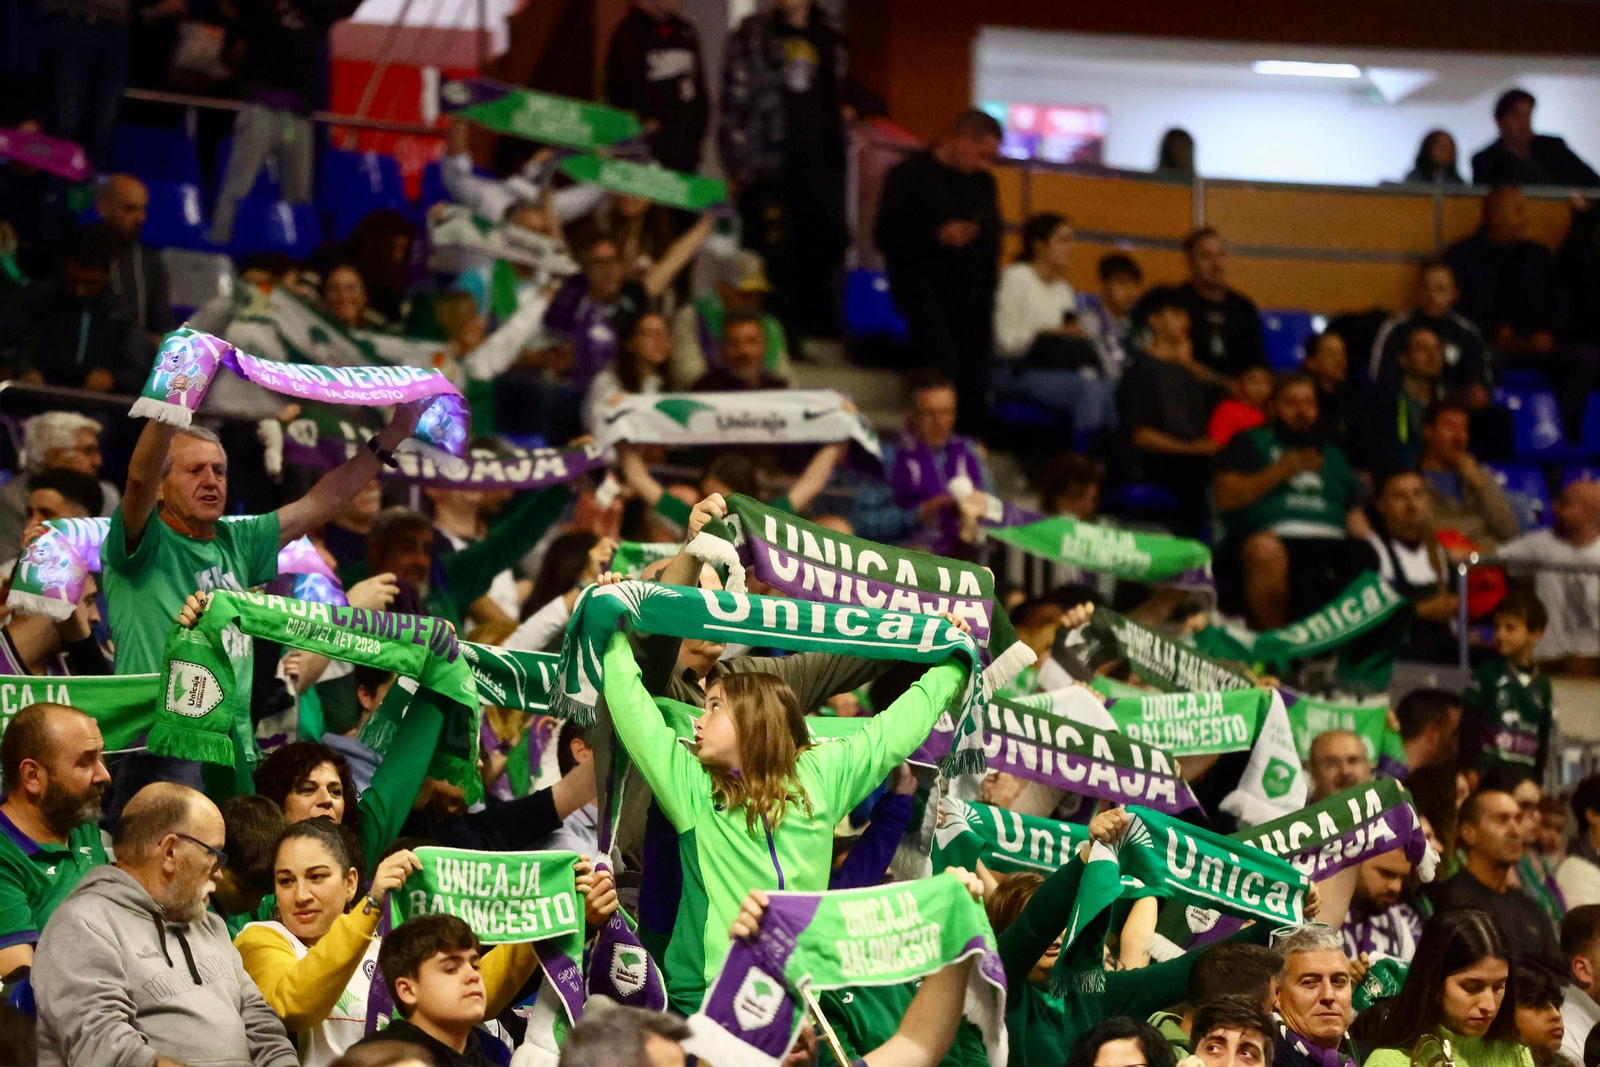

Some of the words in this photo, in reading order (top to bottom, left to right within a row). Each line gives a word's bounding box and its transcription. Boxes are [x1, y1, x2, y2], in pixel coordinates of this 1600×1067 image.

[323, 365, 432, 389] VERDE
[323, 387, 404, 400] BALONCESTO
[764, 514, 989, 628] UNICAJA
[285, 617, 311, 639] COPA
[313, 625, 330, 645] DEL
[333, 631, 353, 649] REY
[355, 637, 380, 654] 2023
[188, 676, 200, 706] Unicaja
[1141, 691, 1223, 721] UNICAJA
[1126, 714, 1248, 749] BALONCESTO
[436, 856, 541, 897] UNICAJA
[409, 891, 576, 934] BALONCESTO
[838, 889, 923, 937] UNICAJA
